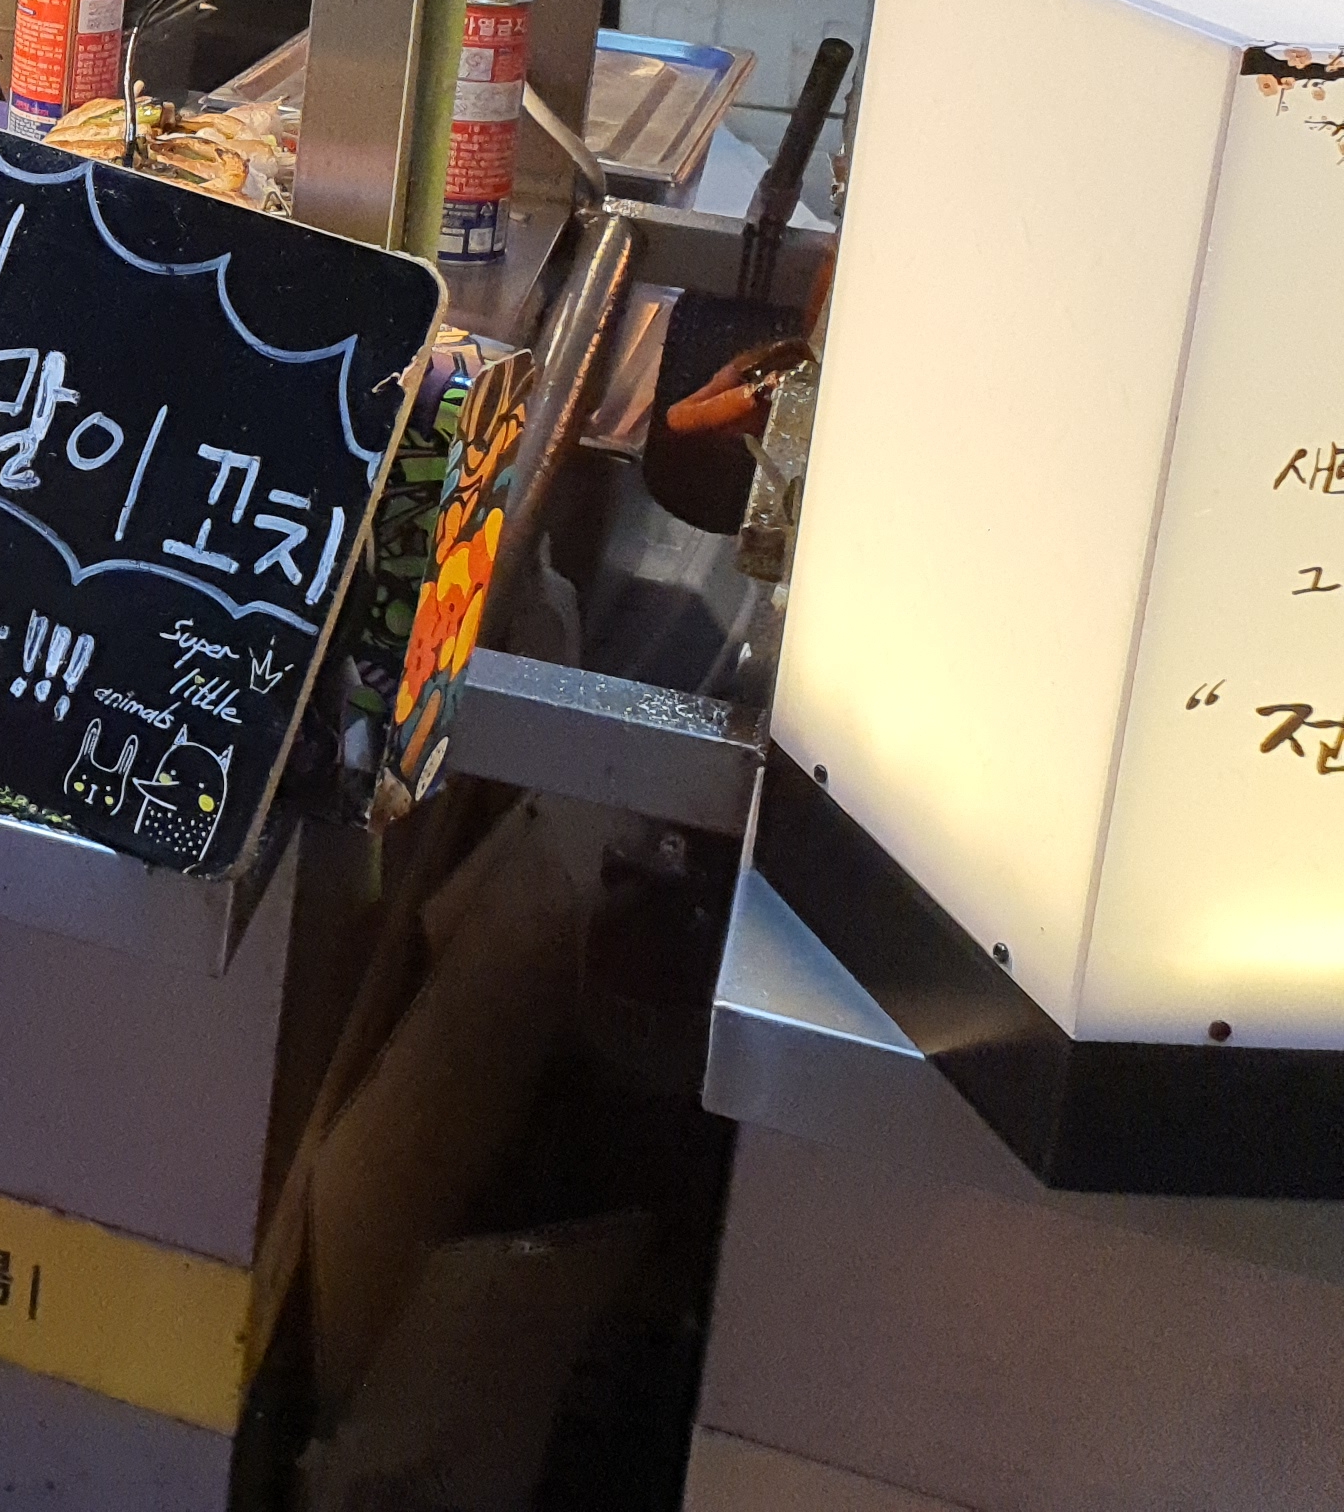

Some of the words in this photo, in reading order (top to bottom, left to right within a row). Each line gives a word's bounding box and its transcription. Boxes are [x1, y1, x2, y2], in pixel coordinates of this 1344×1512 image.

[159, 617, 240, 670] Super
[94, 687, 176, 730] animals
[169, 667, 244, 725] little
